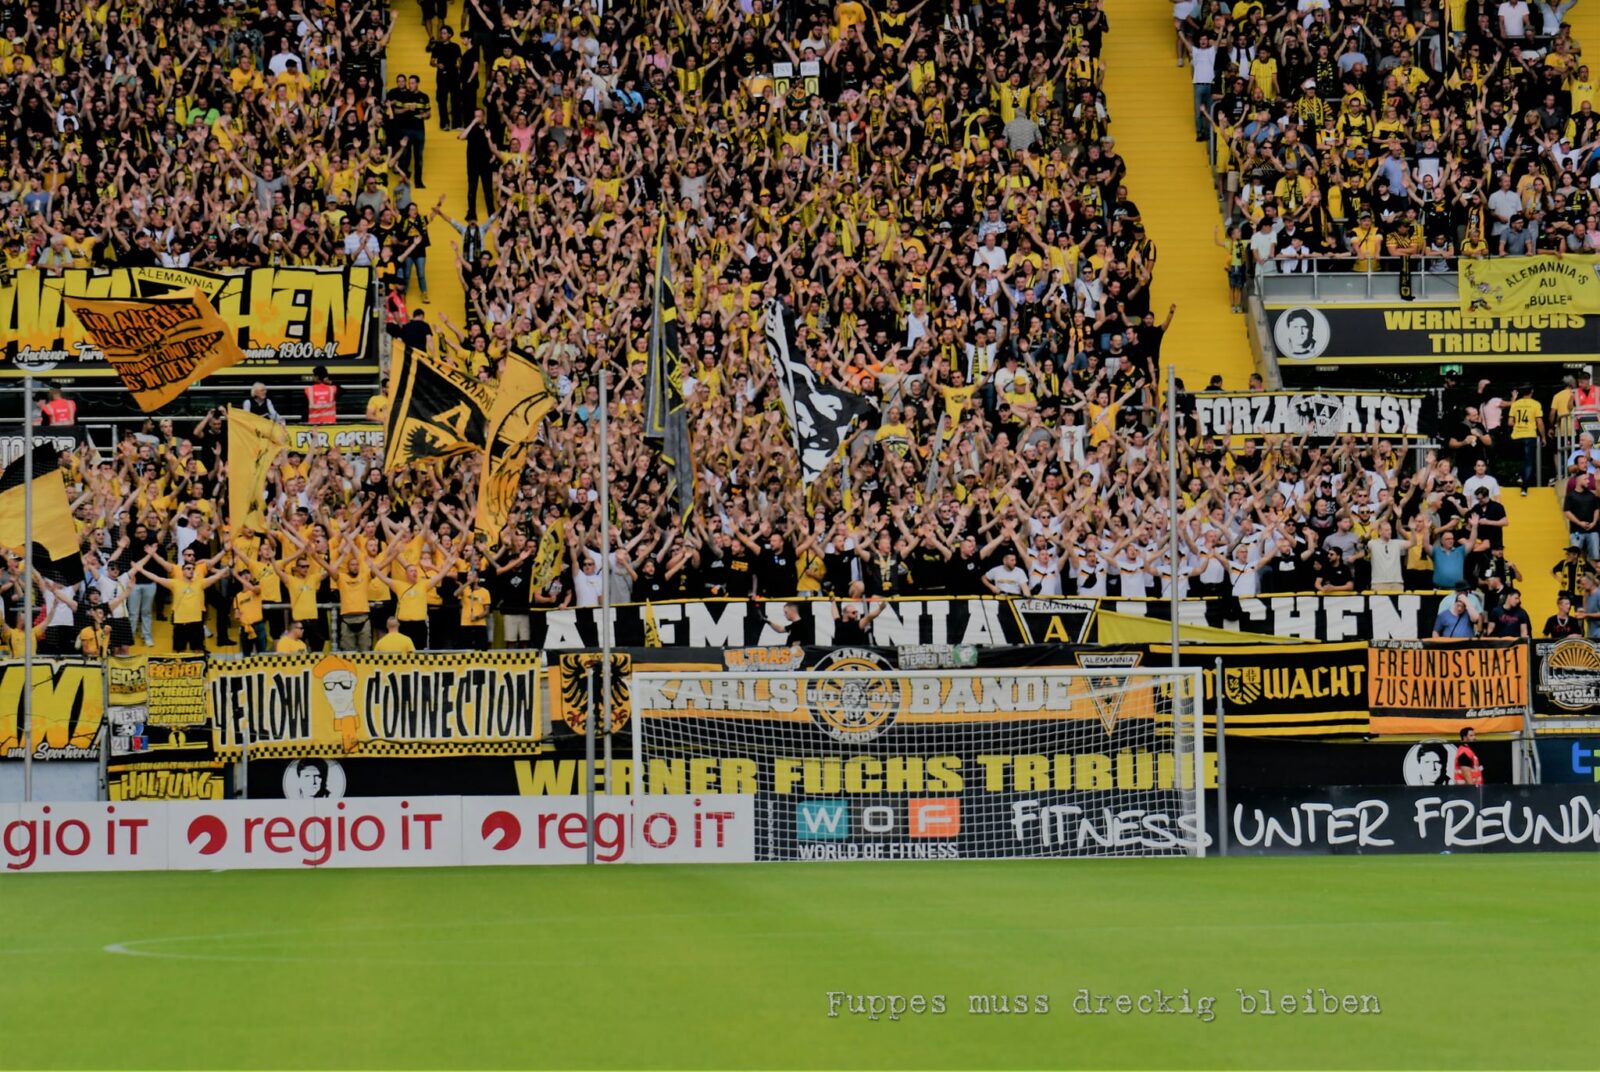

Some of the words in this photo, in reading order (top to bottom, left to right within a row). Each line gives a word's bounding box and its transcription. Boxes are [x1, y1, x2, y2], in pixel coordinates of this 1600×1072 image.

[139, 269, 214, 290] ALEMANNIA
[1505, 261, 1589, 288] ALEMANNIA'S
[1540, 278, 1557, 288] AU
[278, 342, 314, 358] 1900
[1429, 329, 1542, 353] TRIBÜNE
[1196, 396, 1293, 436] FORZA
[1340, 395, 1422, 436] ATSV
[1516, 409, 1529, 423] 14
[1020, 601, 1089, 611] ALEMANNIA
[1043, 615, 1070, 643] A
[1083, 656, 1134, 665] ALEMANNIA
[1377, 647, 1521, 678] FREUNDSCHAFT
[646, 676, 798, 713] KARLS
[908, 676, 1073, 714] BANDE
[1263, 665, 1366, 700] WACHT
[1374, 675, 1522, 708] ZUSAMMENHALT
[1553, 686, 1596, 700] TIVOLI
[211, 670, 310, 746] YELLOW
[364, 669, 535, 740] CONNECTION
[120, 770, 213, 800] HALTUNG
[515, 758, 758, 795] WERNER
[775, 754, 965, 794] FUCHS
[244, 802, 386, 866] regio
[1010, 799, 1213, 849] FITNESS
[1233, 798, 1395, 848] UNTER
[1413, 795, 1600, 847] FREUND
[3, 805, 91, 870] gio
[799, 843, 858, 860] WORLD
[862, 843, 885, 860] OF
[889, 842, 958, 859] FITNESS
